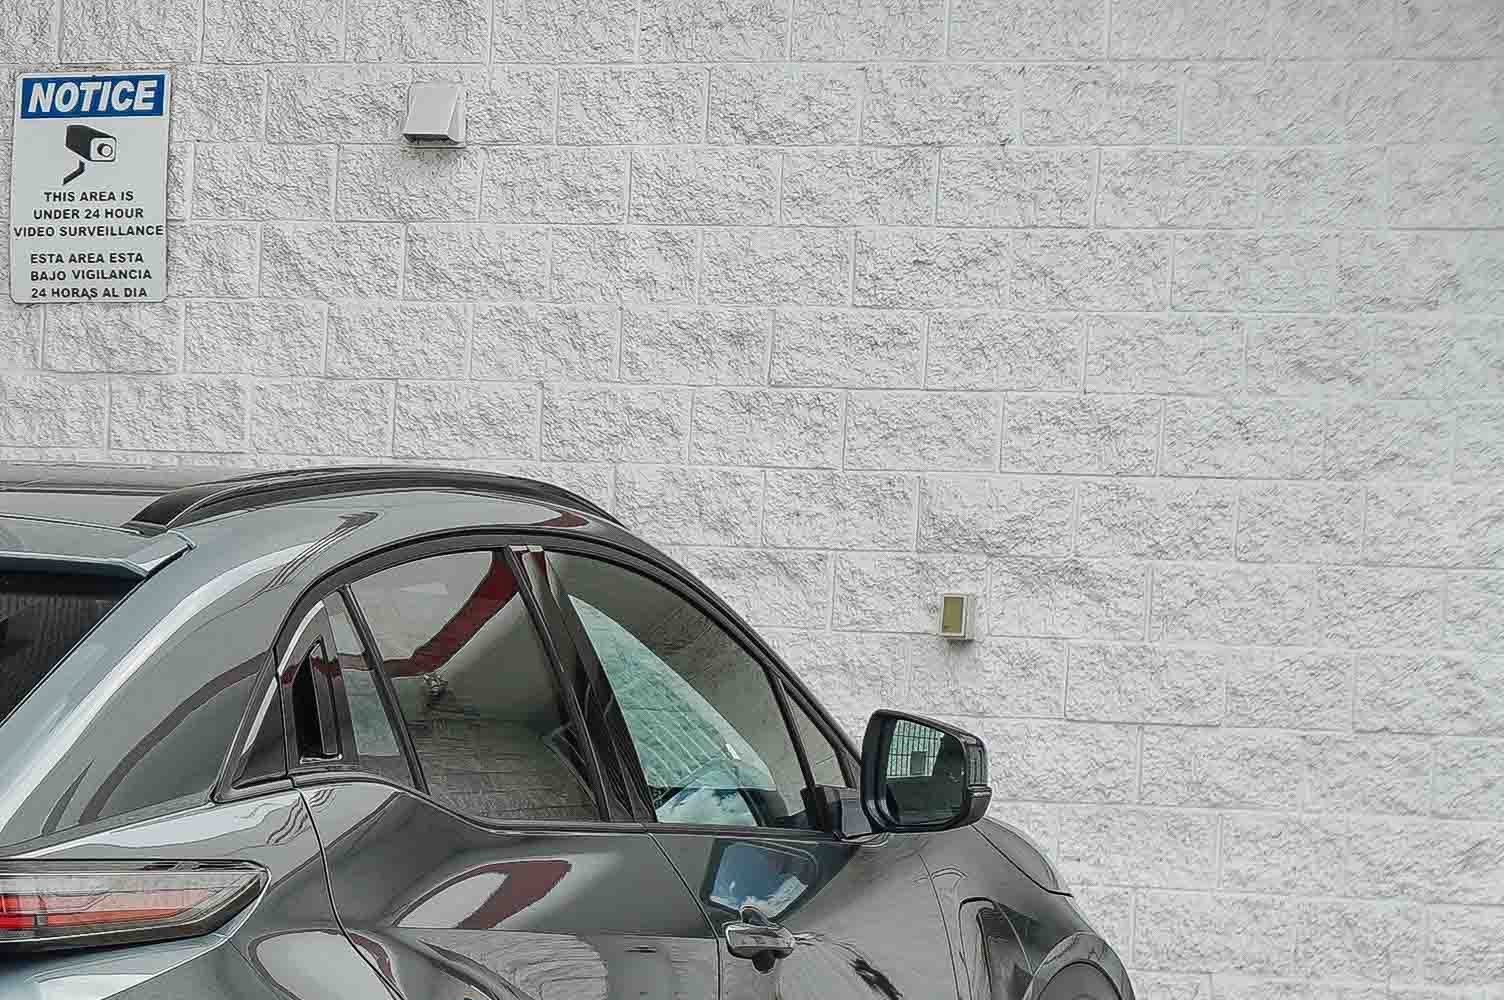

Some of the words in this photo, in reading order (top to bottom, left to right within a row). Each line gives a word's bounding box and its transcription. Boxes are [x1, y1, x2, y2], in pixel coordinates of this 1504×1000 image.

[28, 79, 158, 113] NOTICE
[43, 191, 75, 202] THIS
[79, 191, 116, 202] AREA
[120, 190, 134, 202] IS
[33, 209, 80, 220] UNDER
[84, 208, 101, 219] 24
[104, 208, 144, 219] HOUR
[13, 226, 55, 238] VIDEO
[59, 225, 165, 237] SURVEILLANCE
[30, 253, 64, 264] ESTA
[68, 253, 105, 264] AREA
[109, 252, 144, 263] ESTA
[30, 270, 67, 281] BAJO
[71, 269, 153, 280] VIGILANCIA
[31, 287, 47, 298] 24
[51, 287, 98, 298] HORAS
[102, 287, 119, 298] AL
[124, 287, 148, 298] DIA
